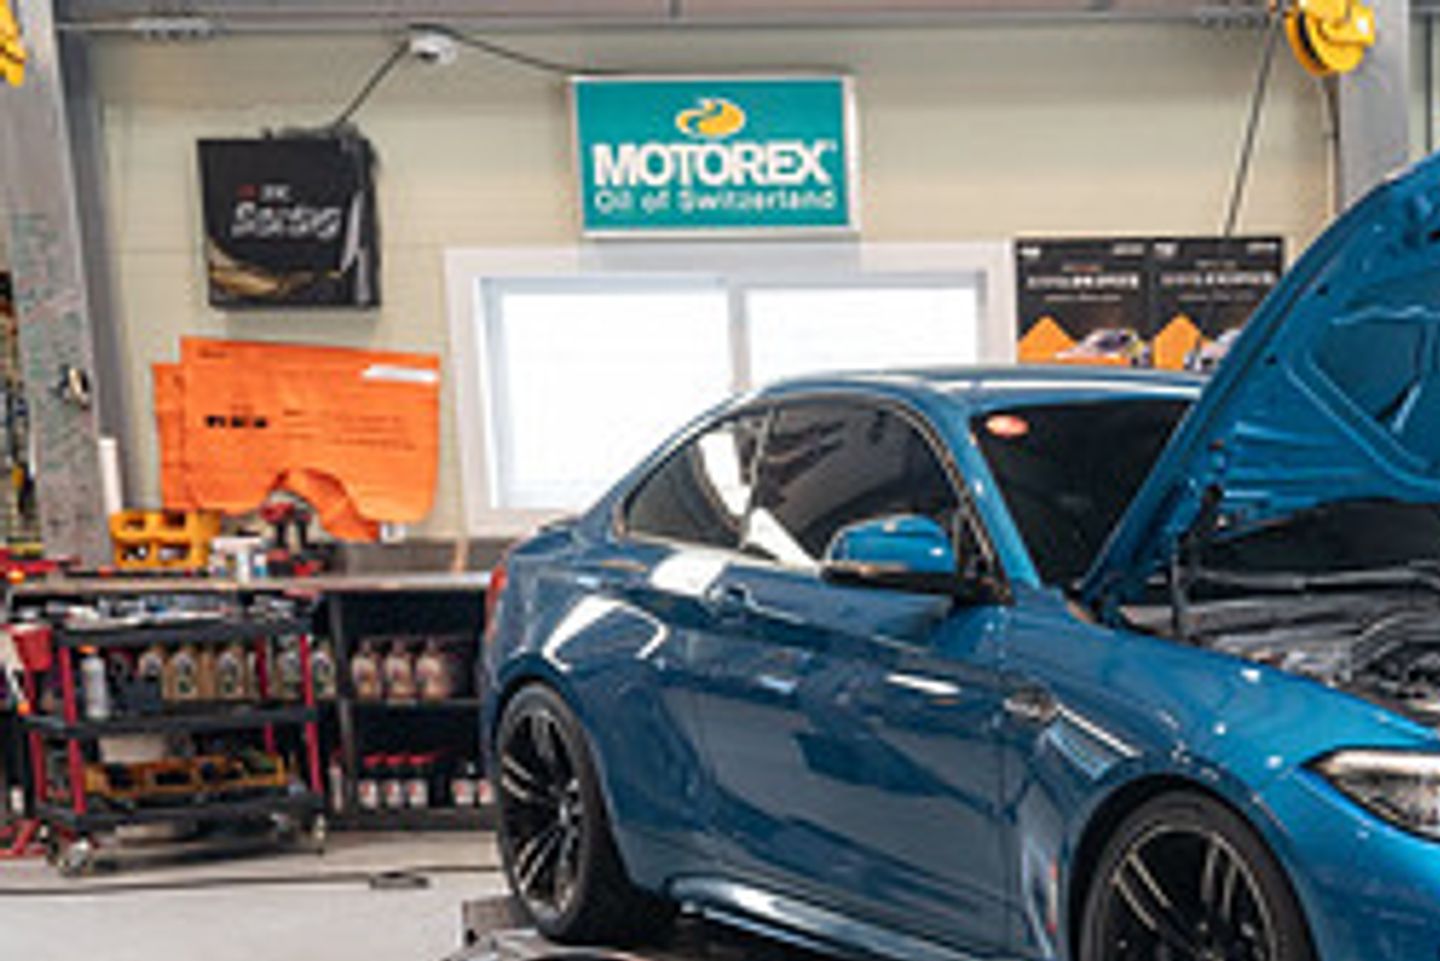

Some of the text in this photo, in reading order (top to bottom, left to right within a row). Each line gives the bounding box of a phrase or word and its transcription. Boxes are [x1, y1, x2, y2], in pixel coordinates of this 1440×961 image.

[592, 141, 832, 187] MOTOREX
[594, 187, 834, 214] Oil of Switzerland
